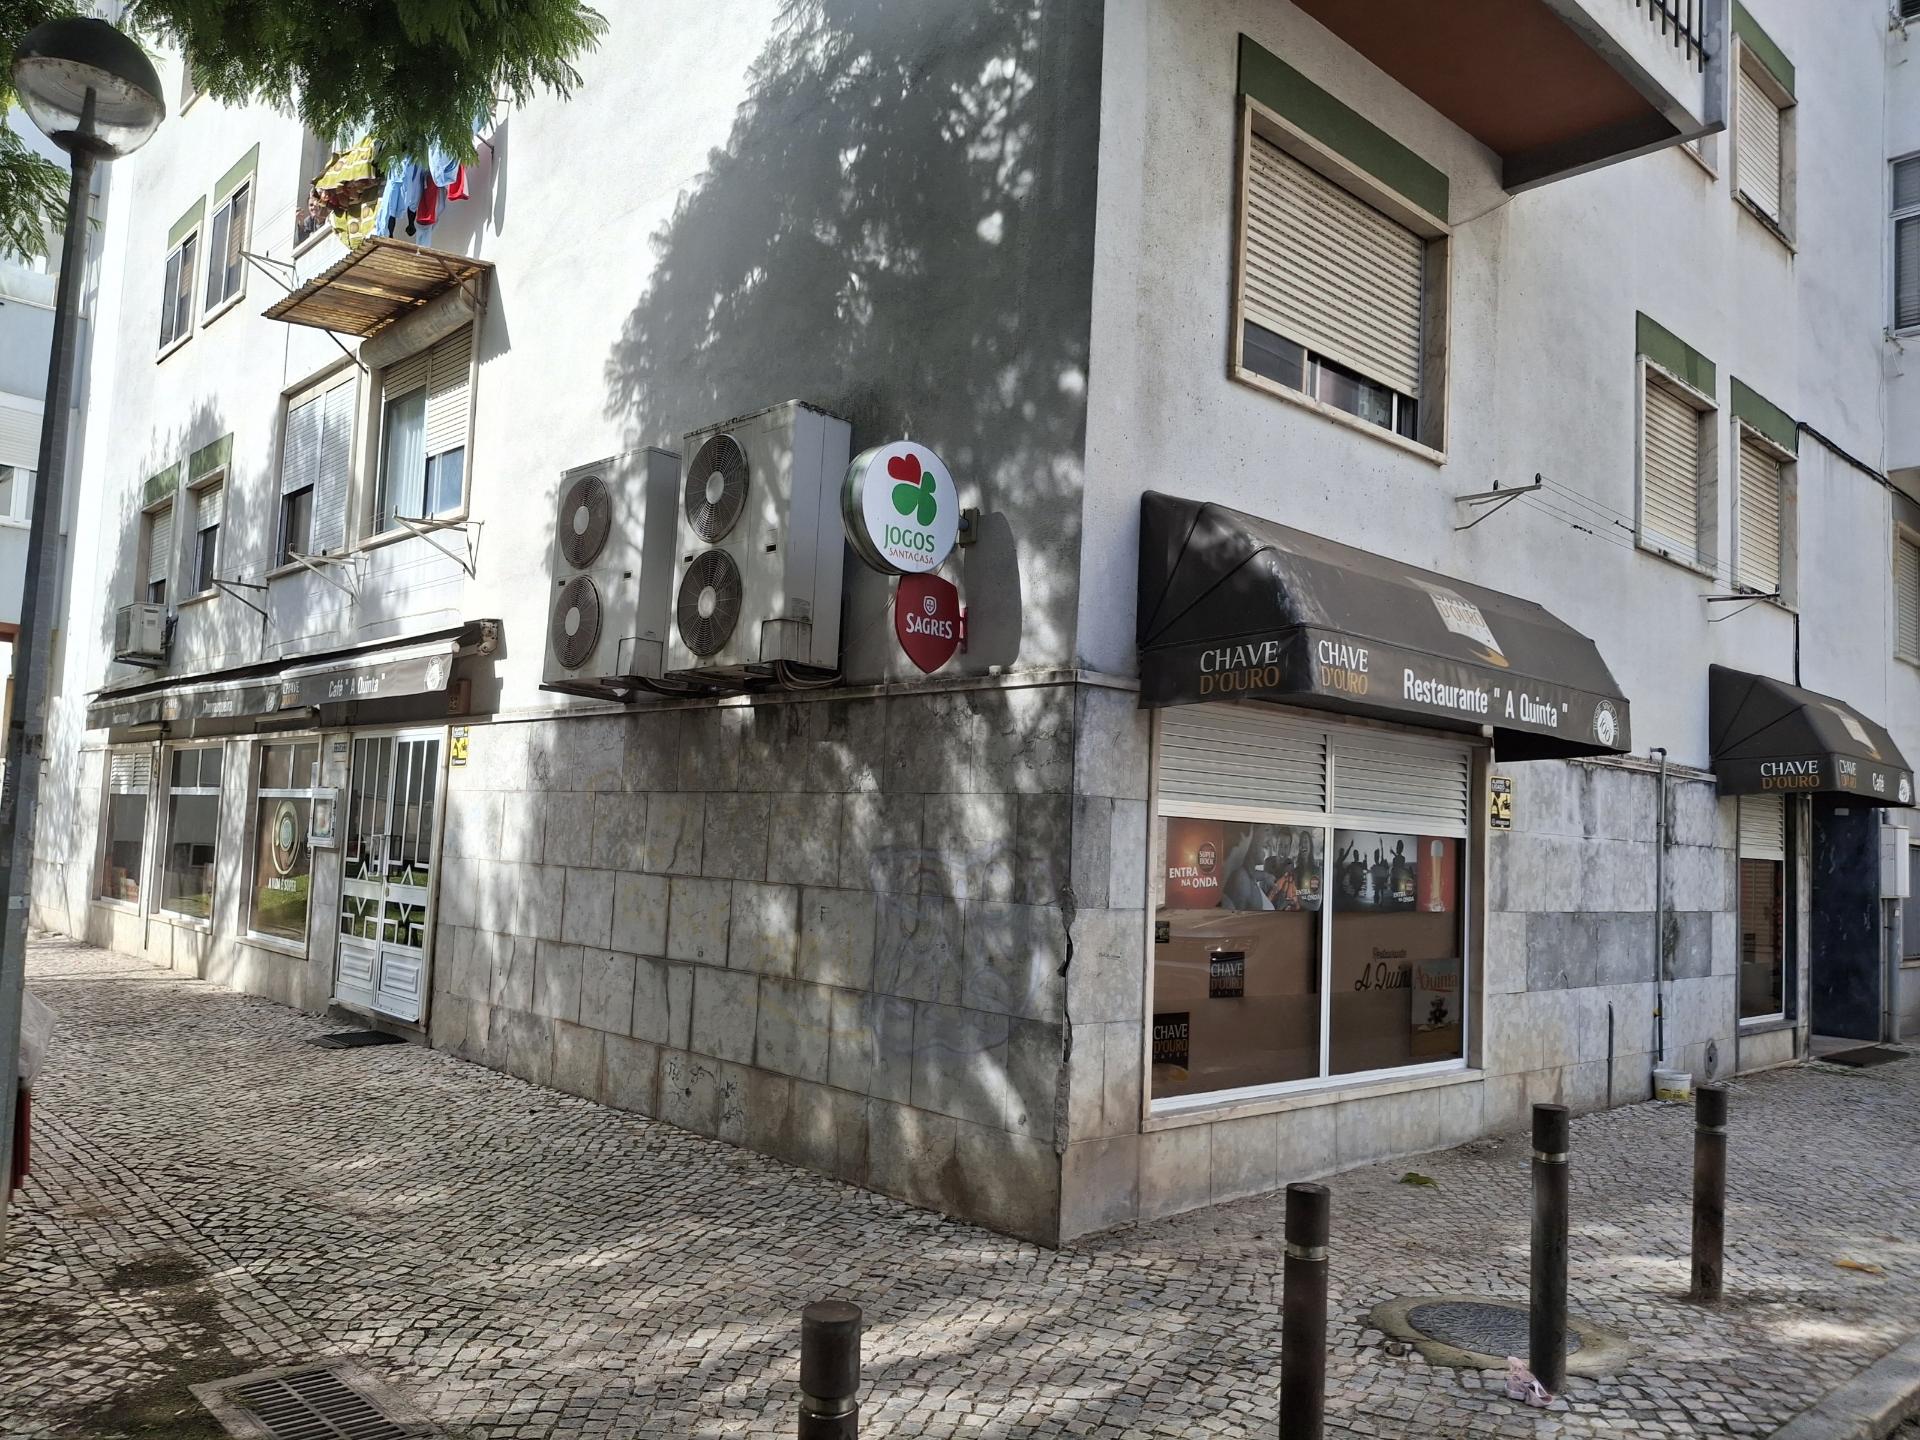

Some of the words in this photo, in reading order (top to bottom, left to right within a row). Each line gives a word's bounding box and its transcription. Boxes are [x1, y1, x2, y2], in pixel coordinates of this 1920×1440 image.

[884, 524, 935, 553] JOGOS
[905, 612, 953, 640] SAGRES
[1200, 640, 1279, 673] CHAVE
[1318, 640, 1369, 673] CHAVE
[328, 679, 343, 698] Café
[357, 676, 379, 693] Quinta
[1199, 665, 1280, 695] D'OURO
[1321, 666, 1369, 695] D'OURO
[1403, 668, 1489, 714] Restaurante
[1505, 690, 1515, 719] A
[1519, 693, 1558, 728] Quinta
[1760, 760, 1819, 777] CHAVE
[1839, 759, 1857, 776] CHAVE
[1762, 774, 1820, 790] D'OURO
[1872, 772, 1885, 793] Café
[1199, 850, 1215, 858] SUPER
[1169, 867, 1198, 879] ENTRA
[1181, 879, 1191, 887] NA
[1192, 877, 1218, 888] ONDA
[1211, 963, 1243, 977] CHAVE
[1153, 1023, 1188, 1040] CHAVE
[1153, 1039, 1188, 1054] D'OURO
